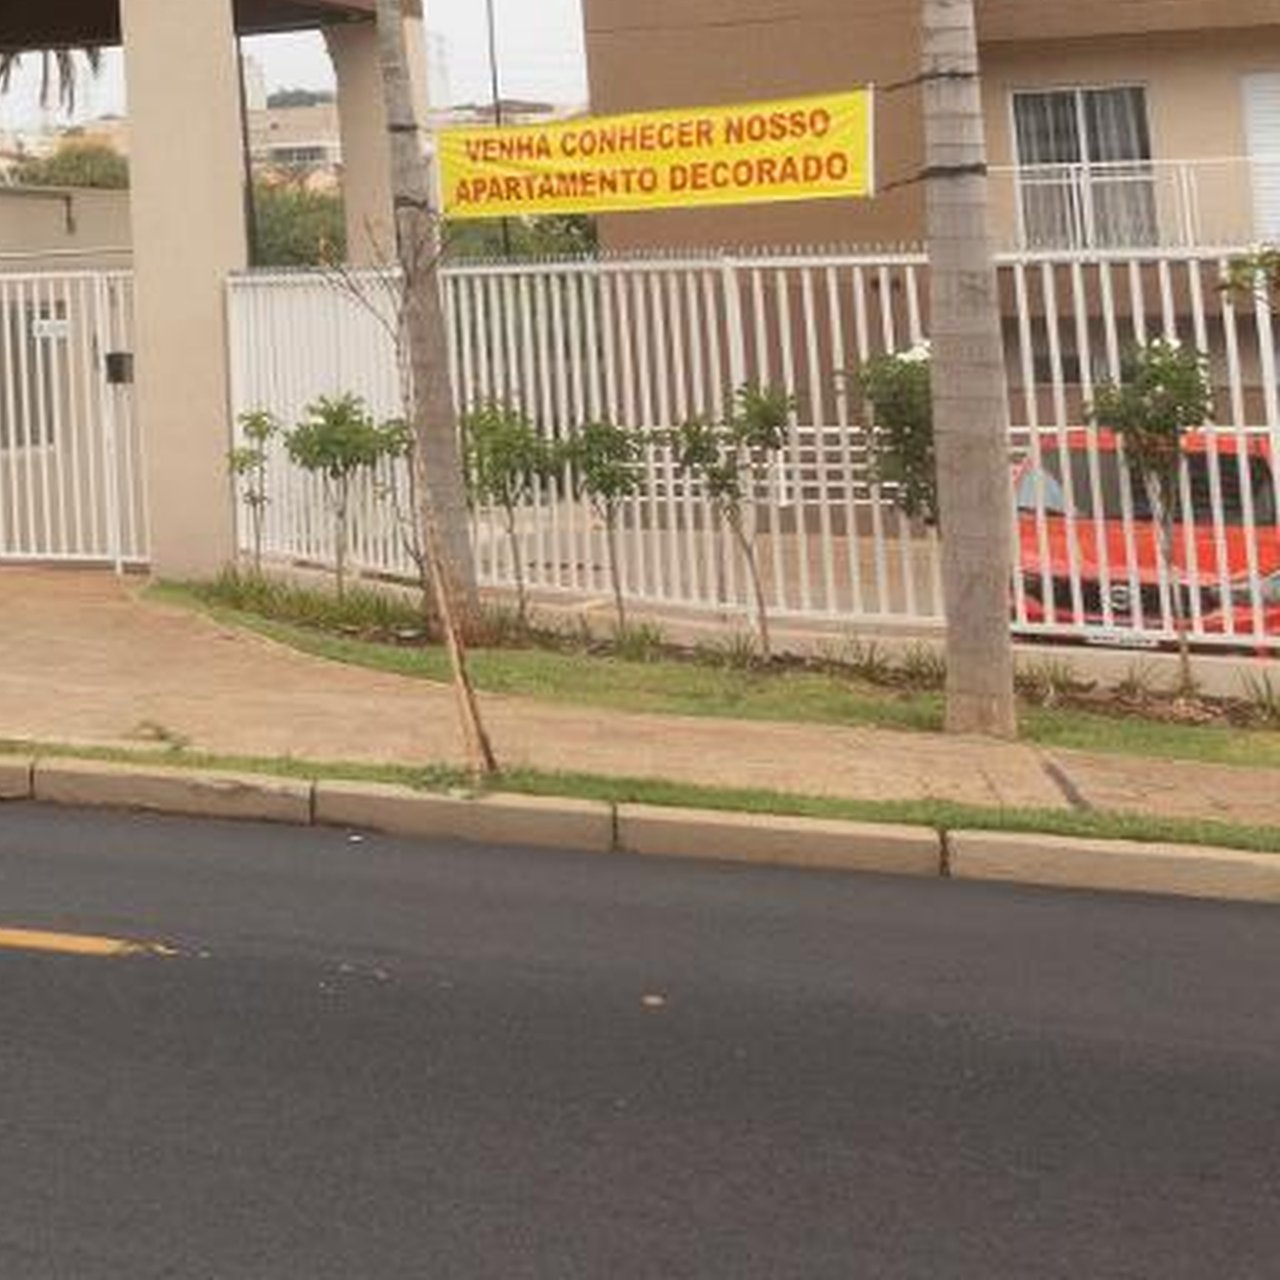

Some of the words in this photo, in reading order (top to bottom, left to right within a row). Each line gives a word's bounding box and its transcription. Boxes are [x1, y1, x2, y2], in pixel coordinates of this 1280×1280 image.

[464, 133, 552, 163] VENHA
[559, 118, 714, 158] CONHECER
[724, 107, 832, 145] NOSSO
[454, 166, 658, 205] APARTAMENTO
[668, 151, 849, 193] DECORADO
